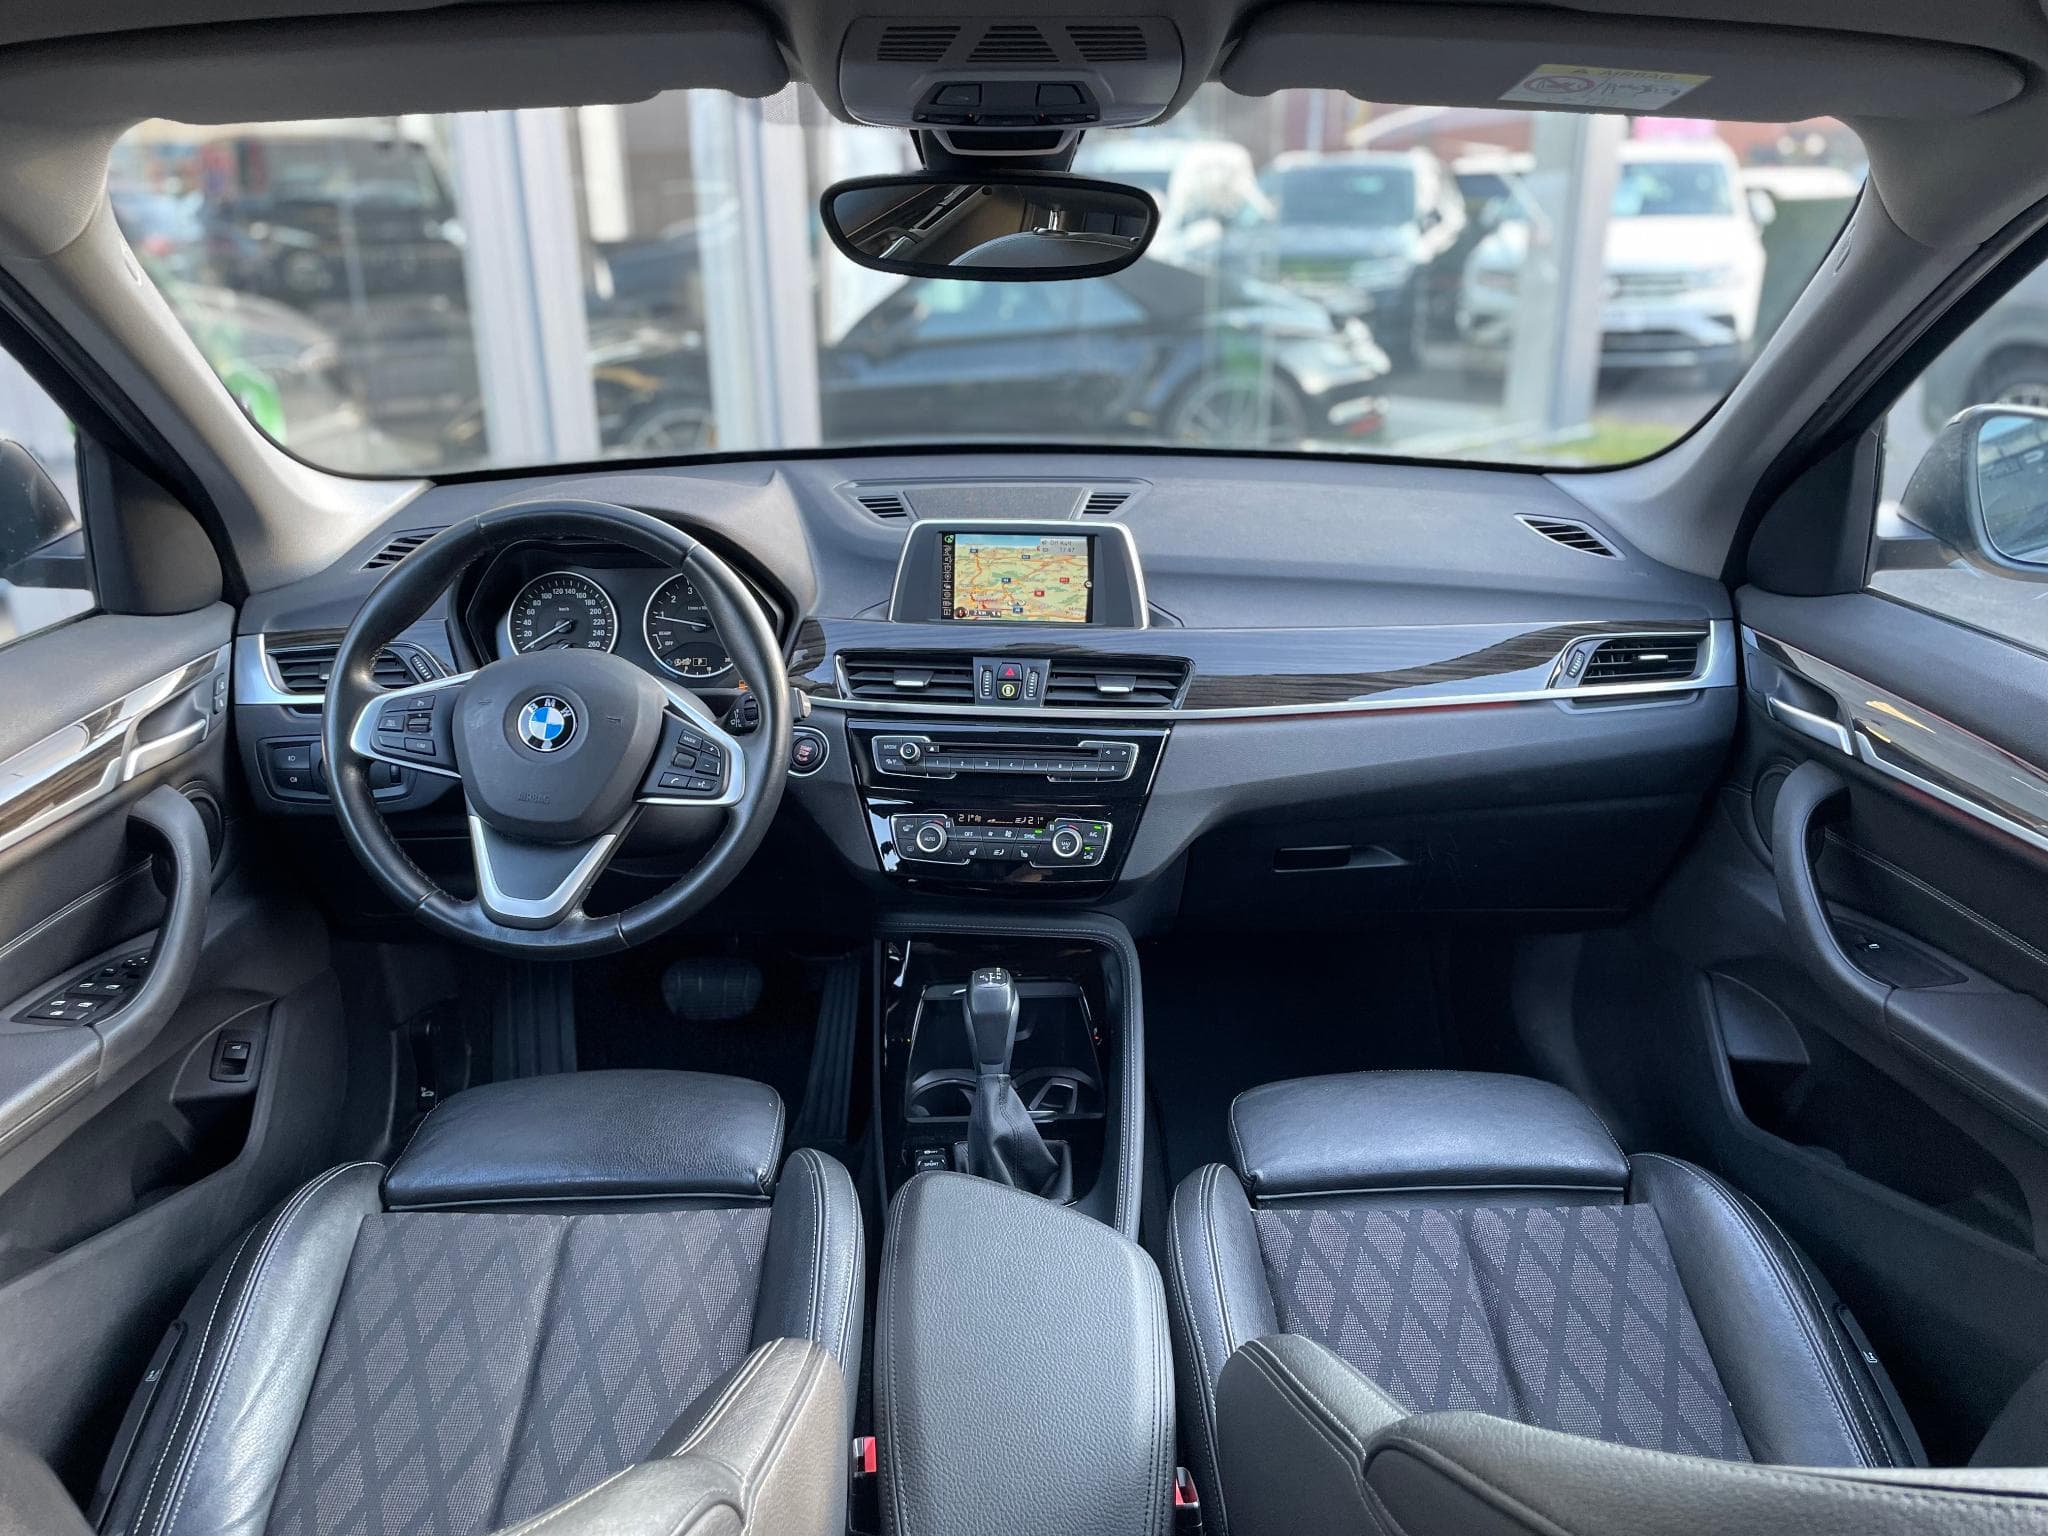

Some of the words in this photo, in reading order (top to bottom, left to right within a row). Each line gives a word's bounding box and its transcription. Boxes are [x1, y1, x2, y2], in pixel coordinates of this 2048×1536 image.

[1601, 69, 1674, 81] AIRBAG
[671, 595, 677, 603] 2
[527, 698, 572, 718] BMW
